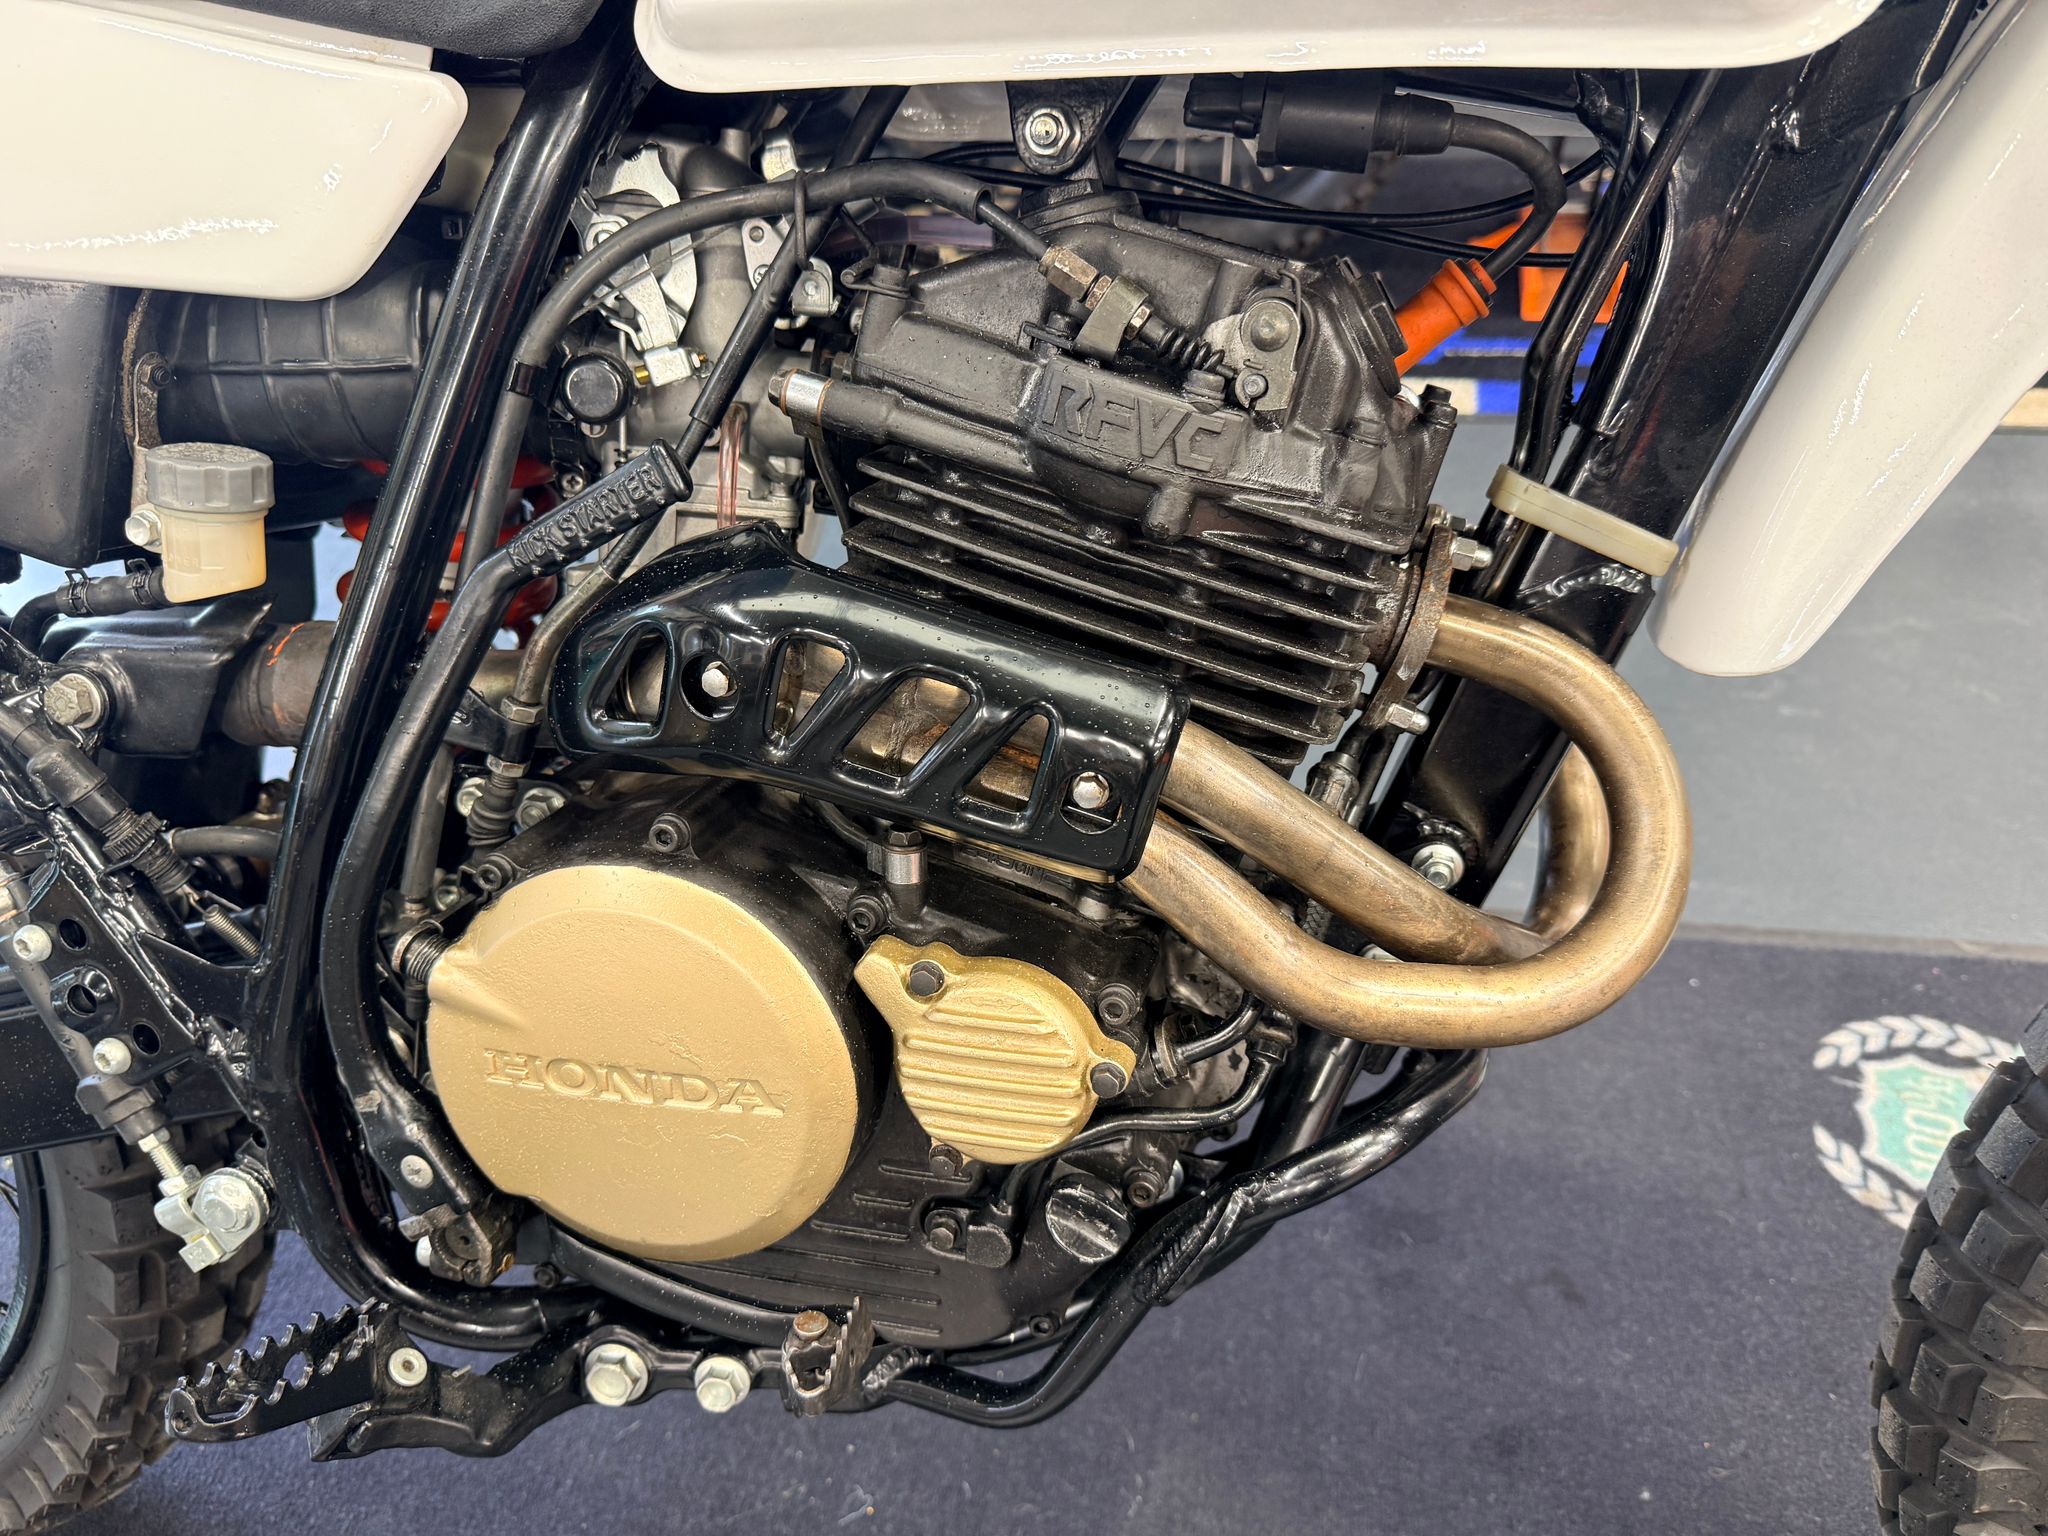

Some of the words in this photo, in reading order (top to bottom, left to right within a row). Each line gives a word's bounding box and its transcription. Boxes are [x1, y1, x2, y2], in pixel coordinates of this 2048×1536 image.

[1042, 371, 1225, 472] RFVC
[508, 522, 570, 566] KICK
[559, 462, 662, 537] STARTER
[484, 1048, 784, 1116] HONDA
